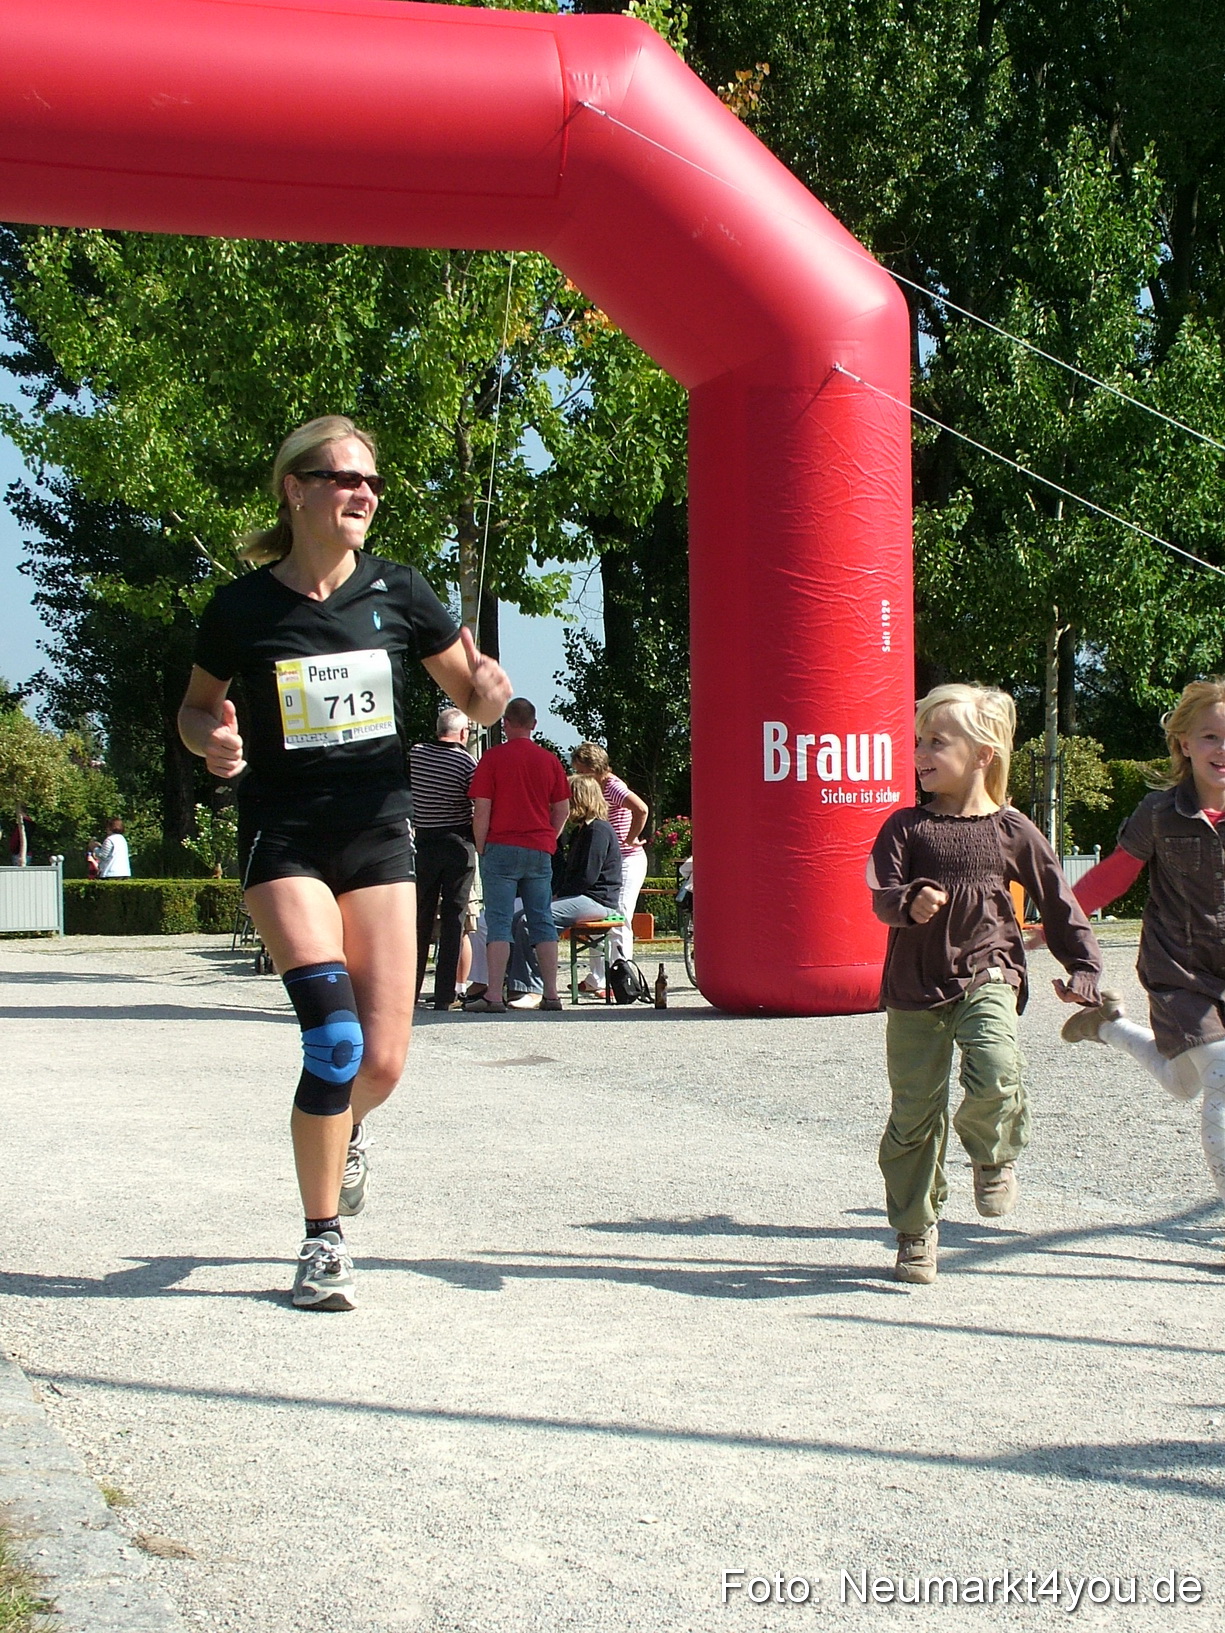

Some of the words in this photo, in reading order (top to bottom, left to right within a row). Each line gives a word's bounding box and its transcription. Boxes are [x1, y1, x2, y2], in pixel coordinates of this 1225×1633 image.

[881, 599, 891, 628] 1929
[881, 630, 891, 653] Seit
[308, 665, 349, 683] Petra
[323, 690, 376, 720] 713
[353, 721, 393, 735] PFLEIDERER
[763, 721, 893, 782] Braun
[821, 786, 858, 804] Sicher
[860, 788, 873, 804] ist
[875, 785, 901, 804] sicher
